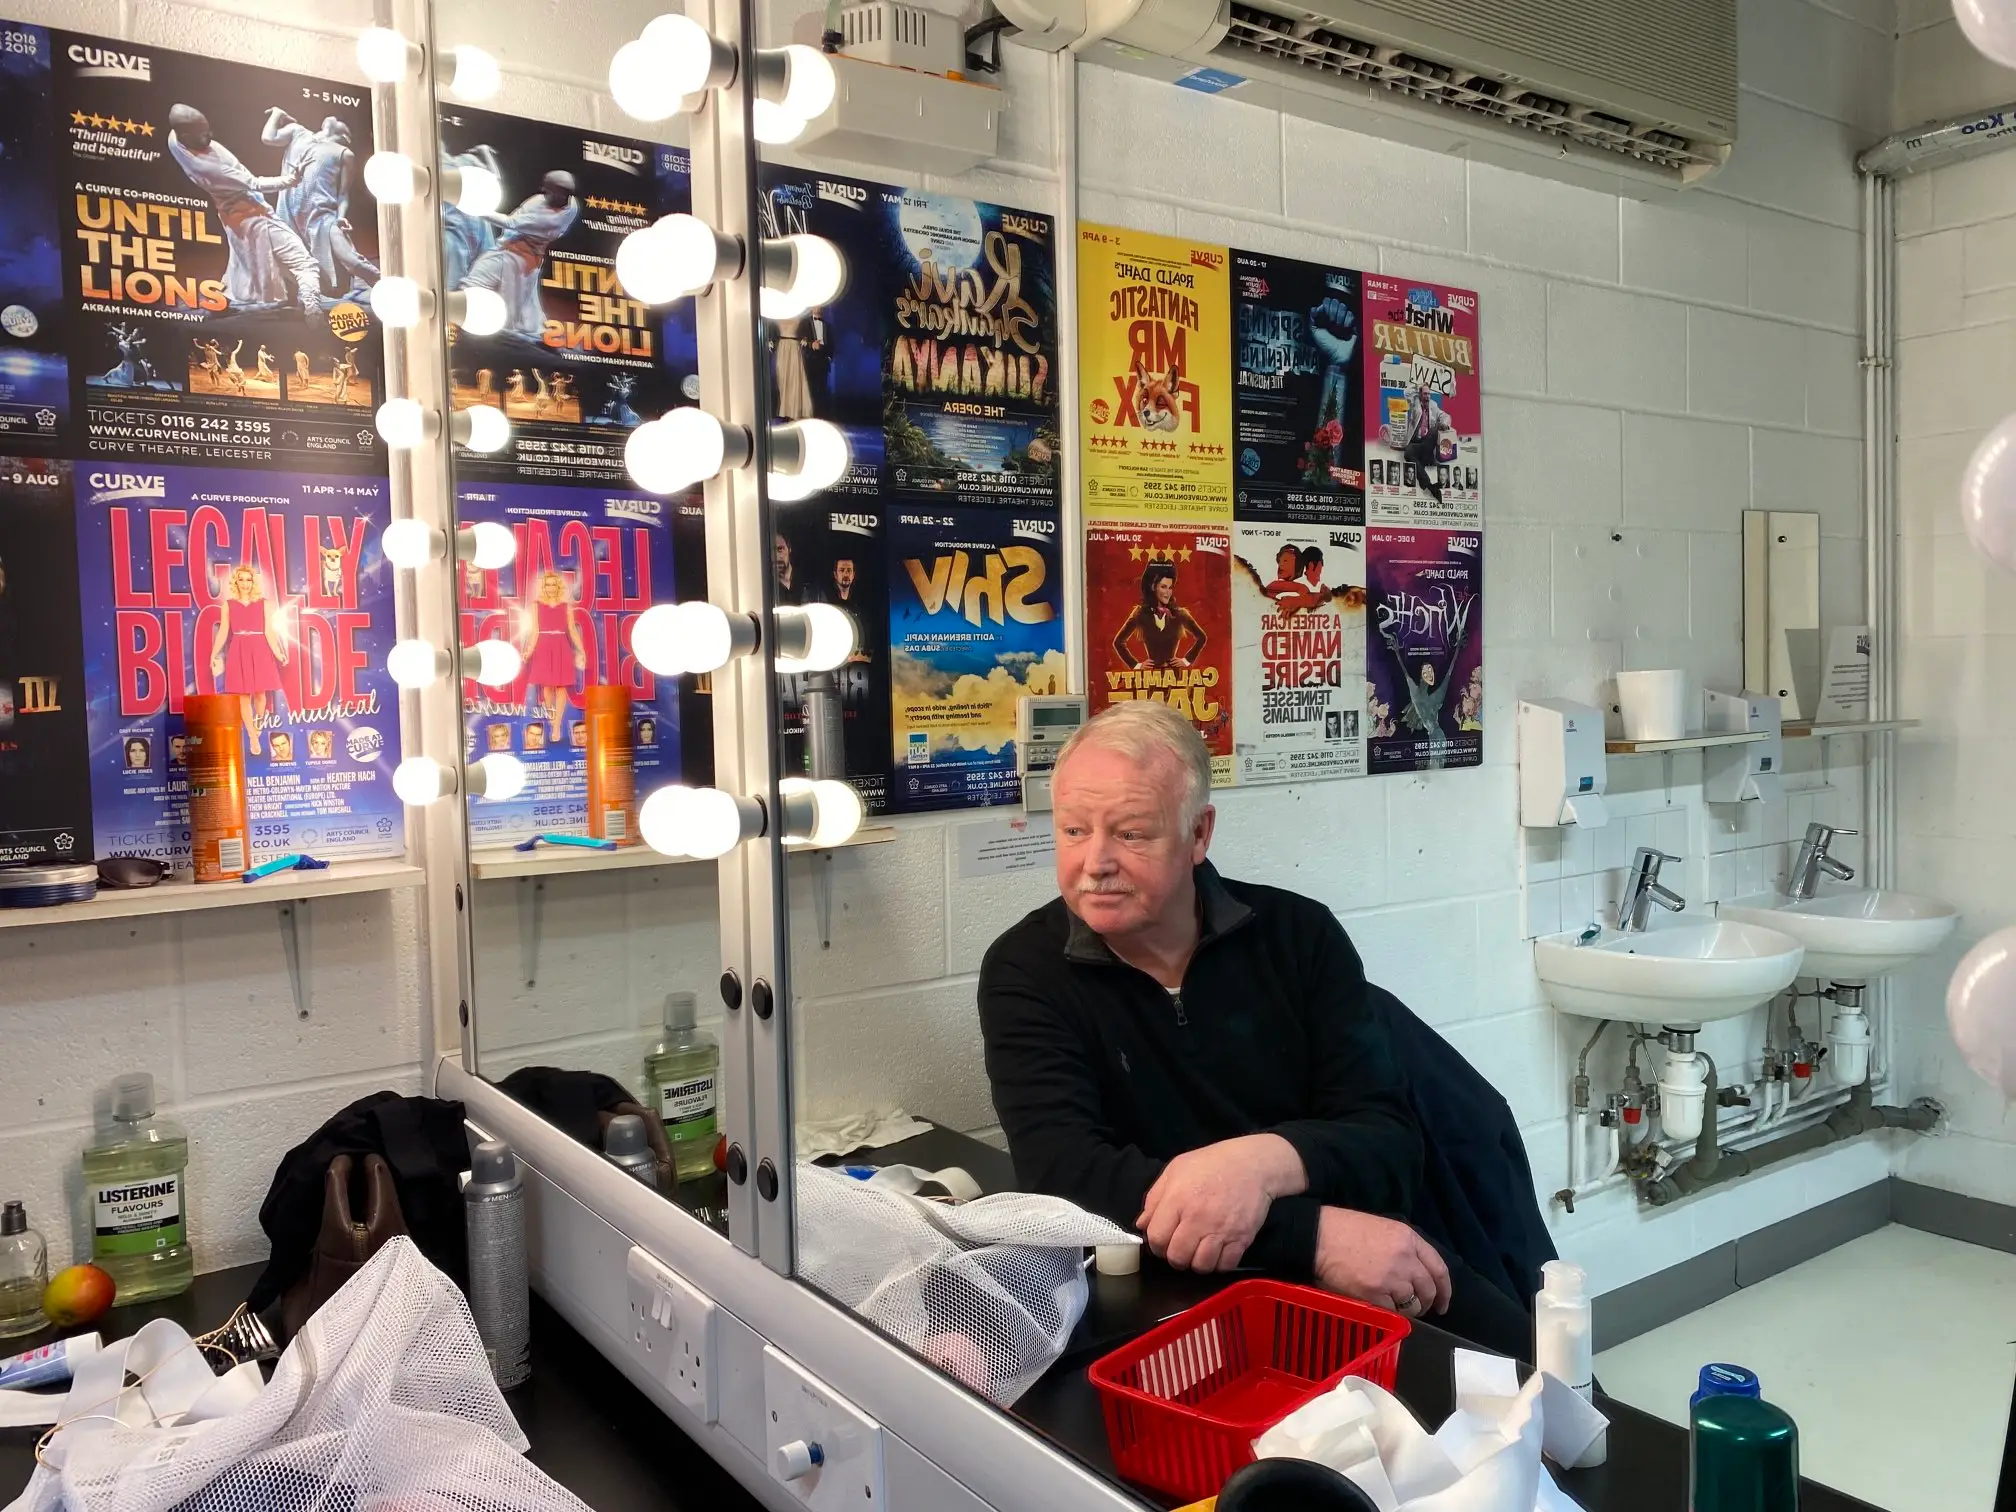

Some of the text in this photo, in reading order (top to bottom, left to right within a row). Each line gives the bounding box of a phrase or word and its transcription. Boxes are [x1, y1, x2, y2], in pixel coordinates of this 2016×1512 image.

[5, 31, 36, 44] 2018
[6, 43, 36, 55] 2019
[68, 44, 150, 72] CURVE
[303, 88, 360, 108] 3 5 NOV
[73, 142, 97, 152] and
[75, 182, 208, 208] A CURVE CO-PRODUCTION
[77, 194, 221, 244] UNTIL
[77, 230, 176, 272] THE
[81, 265, 228, 311] LIONS
[82, 302, 205, 322] AKRAM KHAN COMPANY
[329, 311, 367, 323] MADE AT
[330, 317, 369, 331] CURVE
[88, 409, 270, 433] TICKETS 0116 242 3595
[89, 425, 271, 445] WWW.CURVEONLINE.CO.UK
[307, 436, 351, 445] ARTS COUNCIL
[89, 440, 134, 452] CURVE
[206, 448, 272, 460] LEICESTER
[307, 442, 337, 450] ENGLAND
[13, 473, 59, 486] 9 AUG
[89, 473, 165, 490] CURVE
[302, 485, 380, 498] 11 APR 14 MAY
[201, 494, 231, 502] CURVE
[233, 496, 290, 504] PRODUCTION
[110, 505, 367, 609] LEGALLY
[116, 604, 371, 716] BLODE
[252, 690, 381, 730] the musical
[347, 736, 370, 745] MADE
[347, 741, 384, 753] CURVE
[248, 775, 300, 787] NELL BENJAMIN
[327, 770, 376, 783] HEATHER HACH
[255, 824, 290, 836] 3595
[106, 832, 174, 846] TICKETS
[99, 1180, 176, 1204] LISTERINE
[111, 1200, 164, 1214] FLAVOURS
